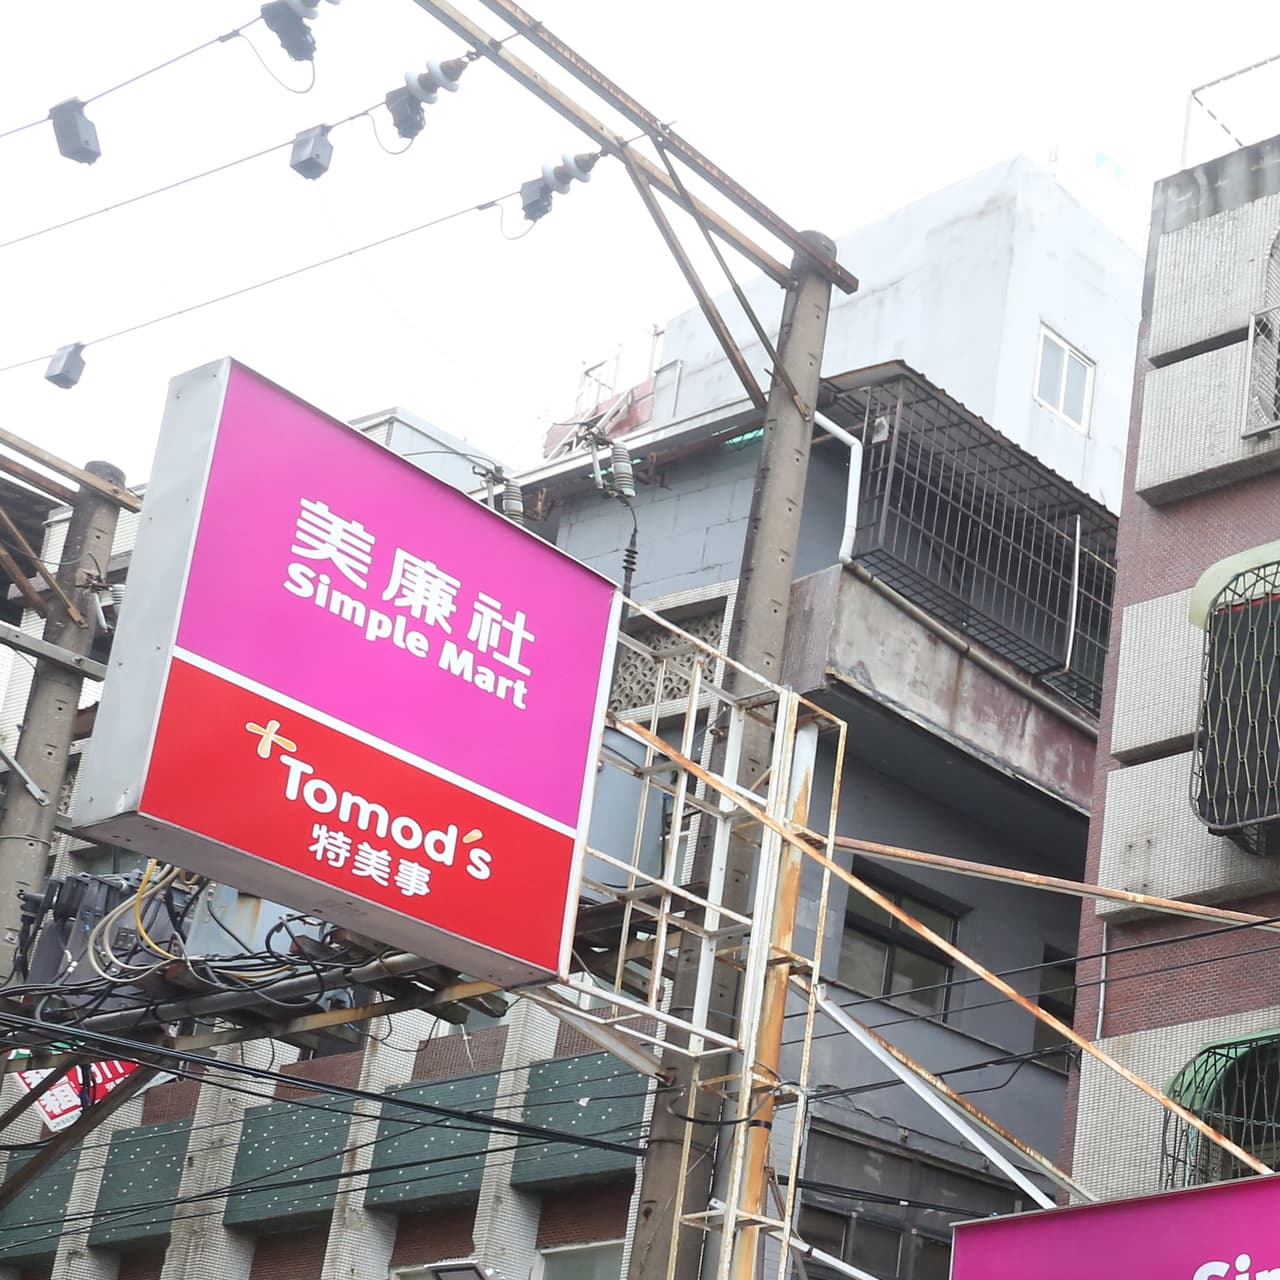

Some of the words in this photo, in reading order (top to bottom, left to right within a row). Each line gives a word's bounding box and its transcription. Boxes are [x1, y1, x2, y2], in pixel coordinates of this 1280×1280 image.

[283, 561, 429, 660] Simple
[439, 638, 529, 710] Mart
[290, 497, 536, 677] 美廉社
[278, 754, 493, 881] Tomod's
[308, 823, 432, 897] 特美事
